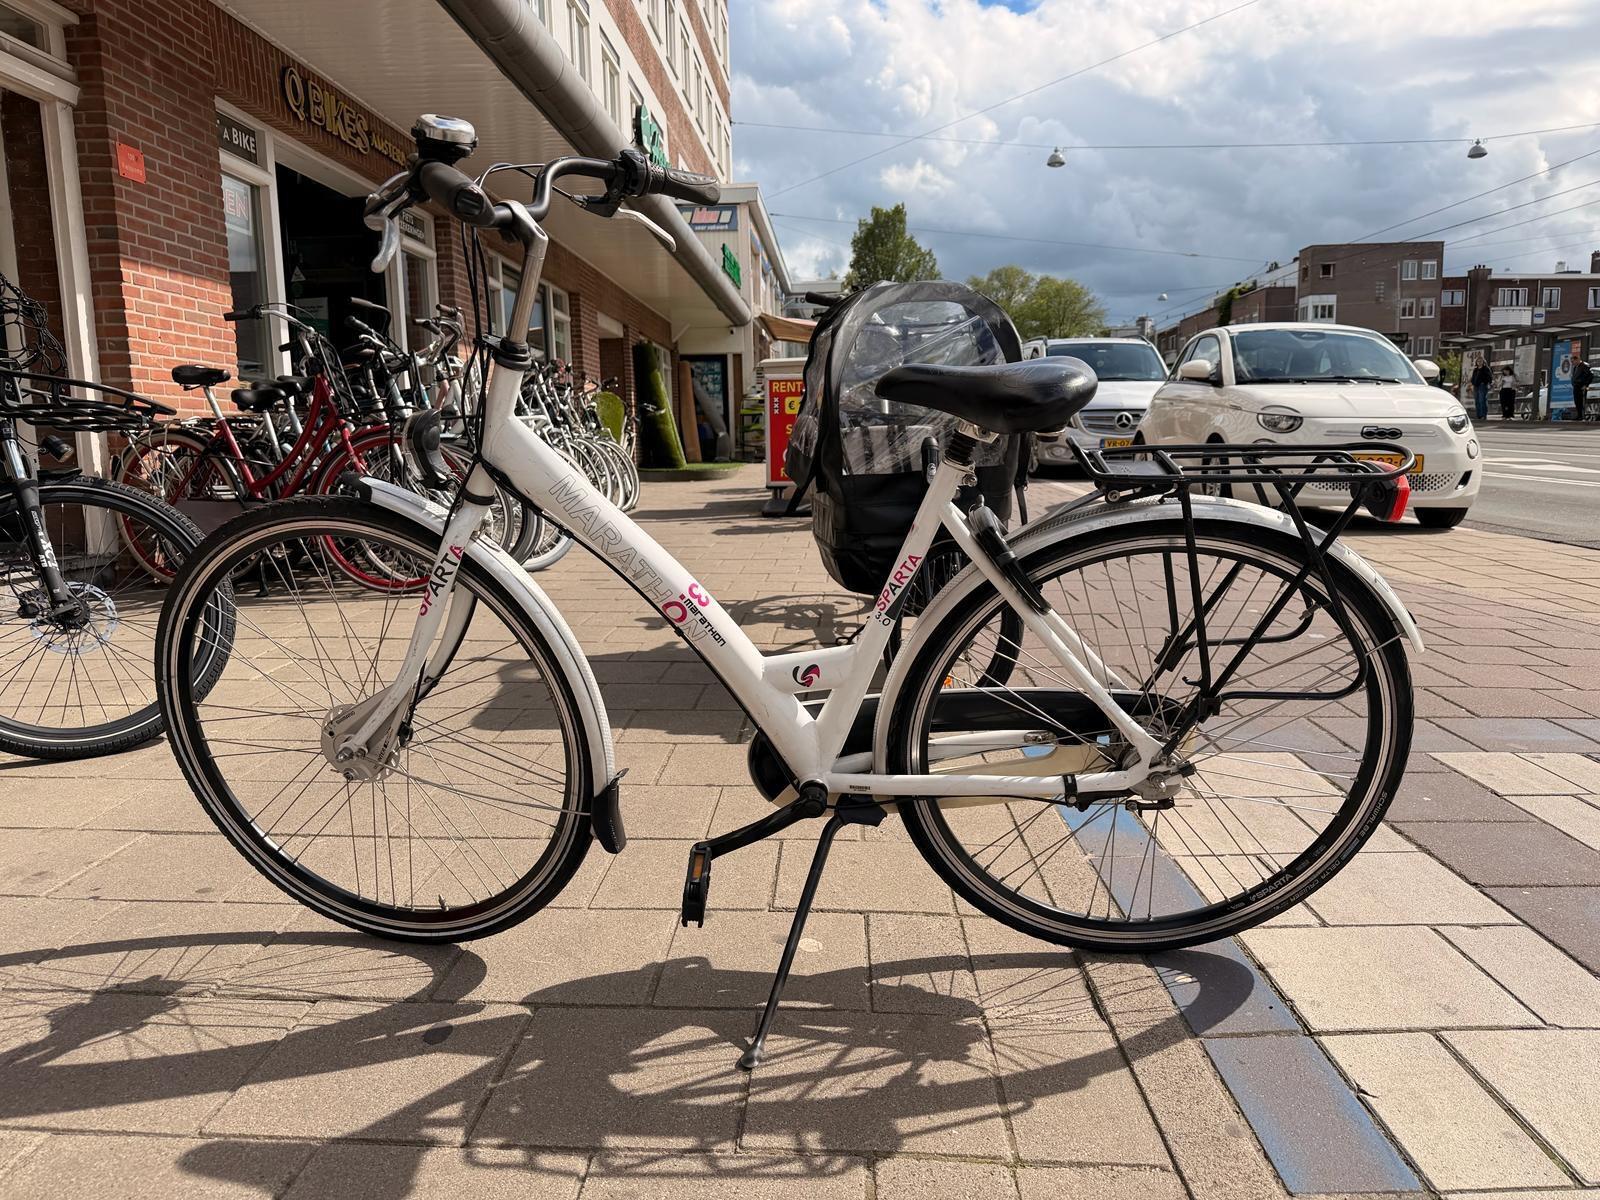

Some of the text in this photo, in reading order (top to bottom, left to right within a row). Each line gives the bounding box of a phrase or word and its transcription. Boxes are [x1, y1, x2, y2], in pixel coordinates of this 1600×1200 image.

[284, 67, 305, 121] Q
[308, 80, 370, 155] BIKES
[223, 127, 256, 154] A BIKE
[224, 189, 249, 220] EN
[772, 382, 803, 393] RENT
[1360, 425, 1403, 440] 500
[549, 474, 708, 643] MARATHON
[876, 554, 922, 611] SPARTA
[1360, 791, 1388, 838] SCHWALBE
[1320, 860, 1341, 880] DELTA
[1255, 873, 1294, 900] SPARTA
